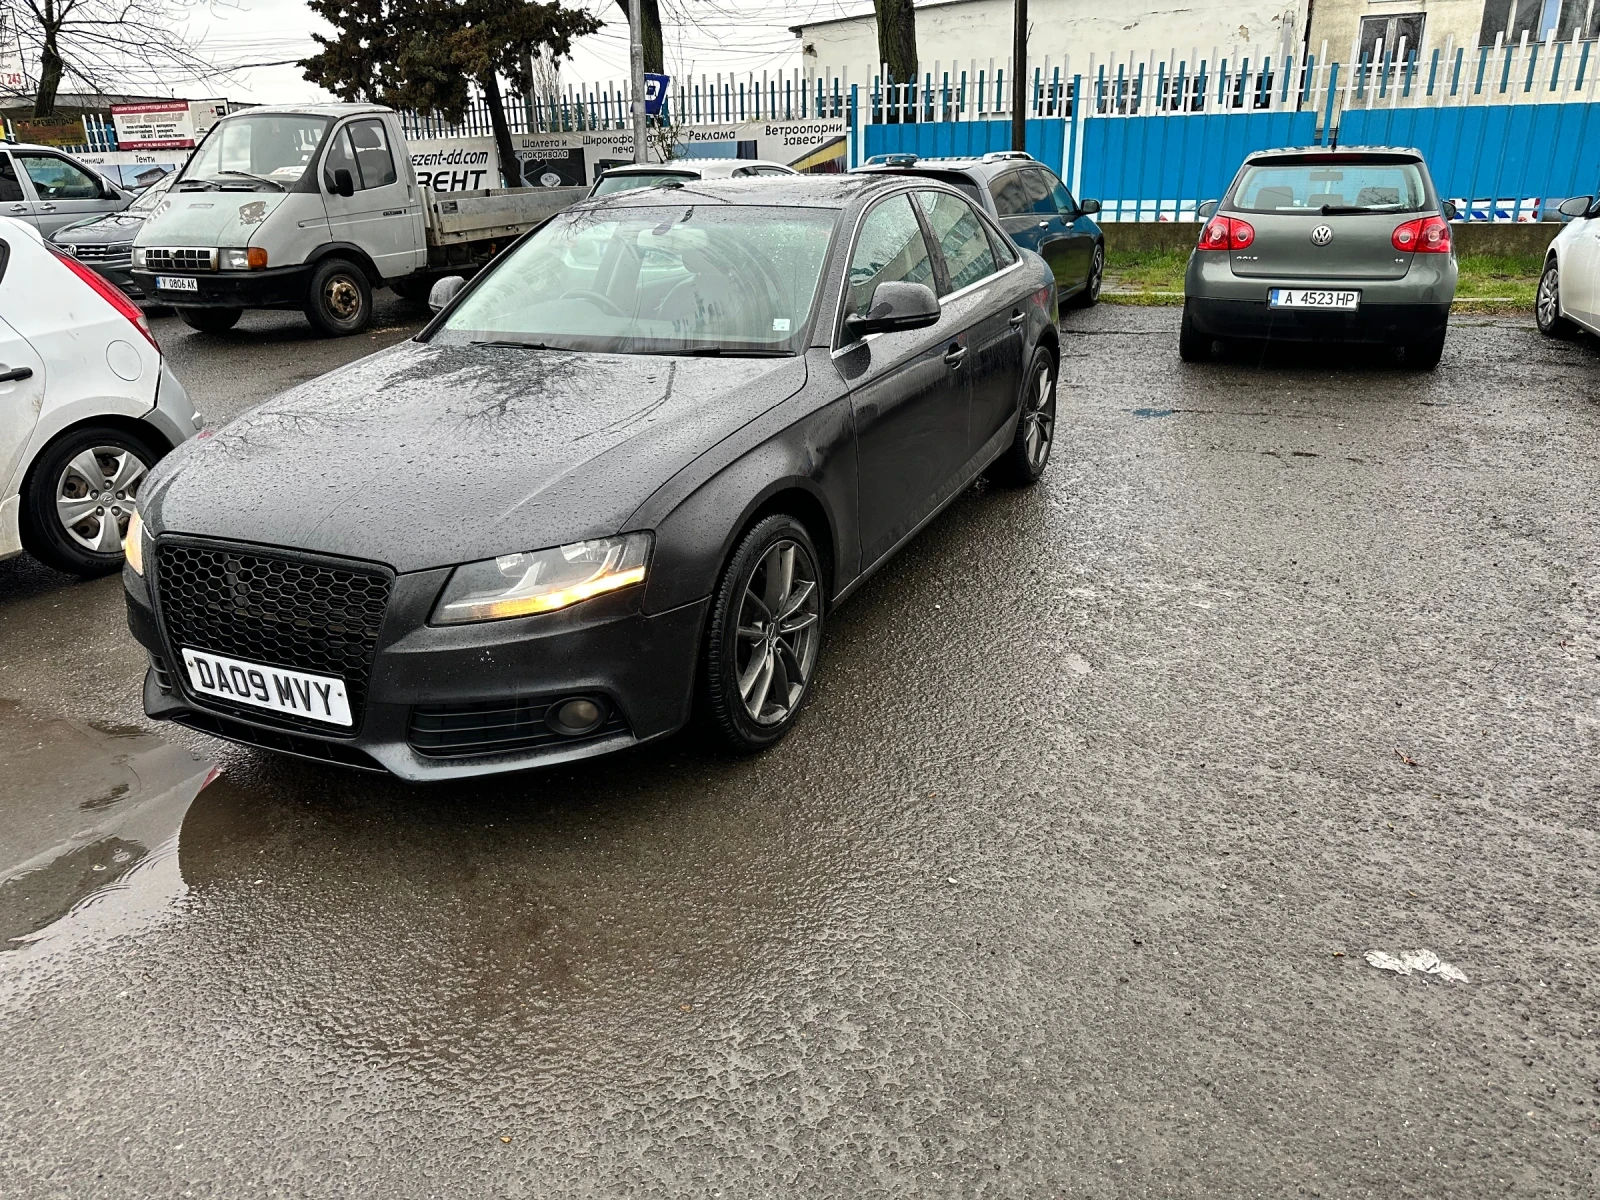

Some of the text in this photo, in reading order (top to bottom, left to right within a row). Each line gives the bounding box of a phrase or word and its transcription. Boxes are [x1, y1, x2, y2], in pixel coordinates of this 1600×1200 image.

[765, 122, 843, 137] Ветроопорни
[688, 130, 736, 141] Реклама
[783, 135, 824, 146] завеси
[522, 139, 560, 148] Шалтета
[135, 155, 156, 164] Тенти
[410, 148, 489, 166] ezent-dd.com
[522, 150, 568, 160] покривала
[415, 169, 487, 193] ЗЕНТ
[169, 279, 186, 289] 0806
[187, 280, 196, 289] AK
[1284, 291, 1355, 306] A 4523 HP
[193, 656, 332, 716] DA09 MVY
